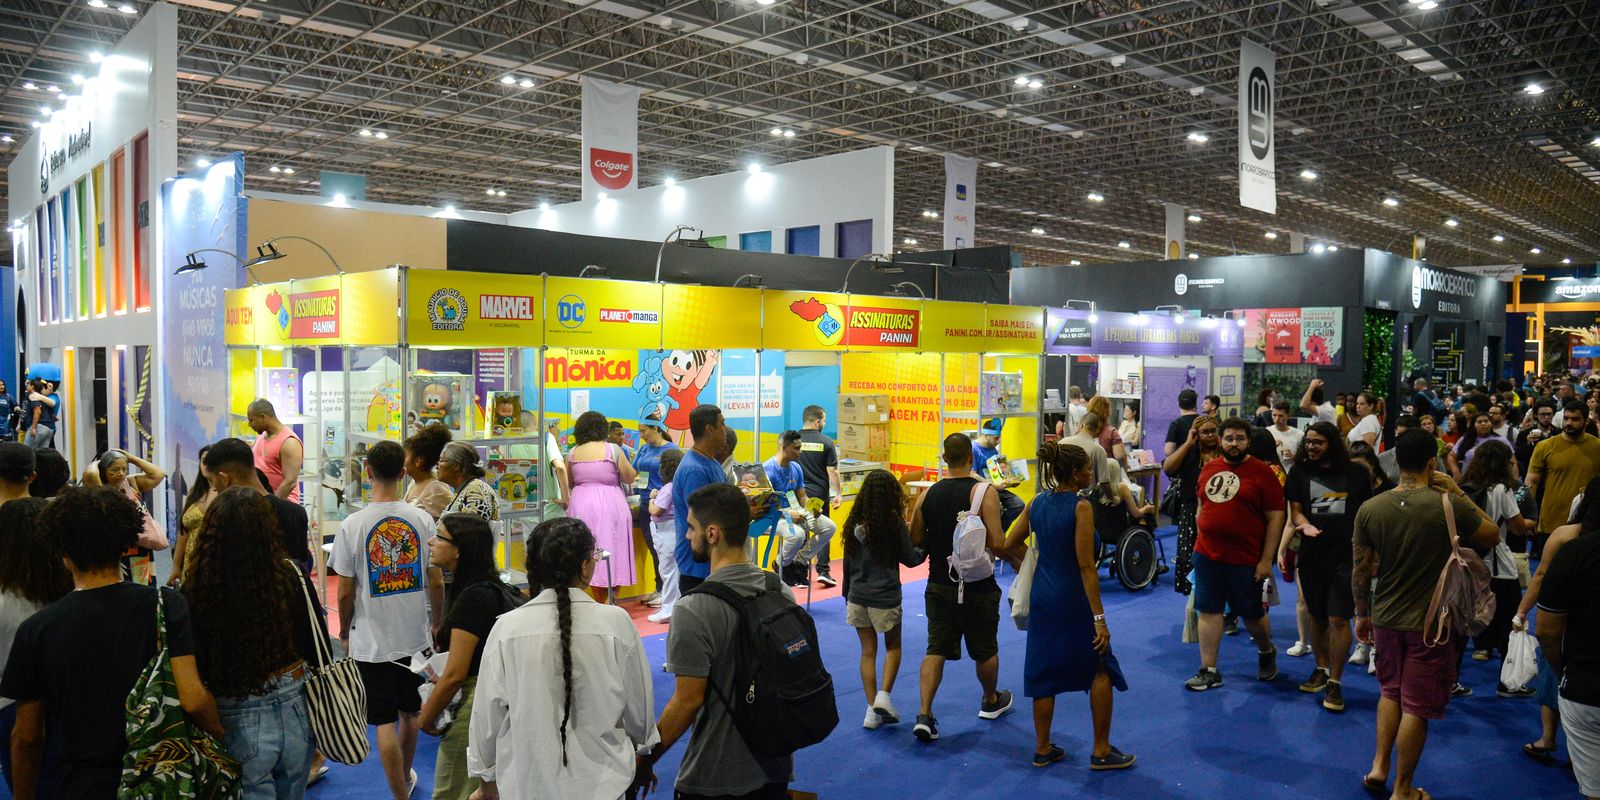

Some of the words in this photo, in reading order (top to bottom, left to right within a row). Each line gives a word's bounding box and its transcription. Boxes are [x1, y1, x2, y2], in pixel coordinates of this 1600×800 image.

[594, 160, 628, 171] Colgate
[1555, 285, 1600, 294] amazon
[180, 286, 216, 311] MÚSICAS
[294, 296, 336, 318] ASSINATURAS
[428, 288, 448, 320] MAURICIO
[449, 288, 460, 297] DE
[458, 296, 468, 323] SOUSA
[480, 296, 532, 319] MARVEL
[558, 302, 584, 322] DC
[1438, 301, 1460, 313] EDITORA
[226, 308, 239, 325] AQUI
[240, 307, 252, 324] TEM
[600, 310, 626, 320] PLANET
[633, 312, 657, 321] manga
[850, 311, 915, 330] ASSINATURAS
[312, 320, 336, 333] PANINI
[1304, 329, 1311, 337] LE
[1313, 329, 1334, 337] GUIN
[880, 332, 912, 343] PANINI
[1104, 327, 1108, 342] A
[1110, 328, 1136, 344] PEQUENA
[183, 346, 213, 367] NUNCA
[888, 382, 926, 392] CONFORTO
[928, 384, 938, 392] DA
[944, 384, 956, 392] UA
[957, 385, 978, 393] CASA
[724, 400, 780, 410] #LEVANTAMÃO
[892, 396, 933, 405] GARANTIDA
[936, 398, 952, 406] CM
[961, 399, 976, 407] SEU
[889, 409, 918, 422] AGEM
[1208, 475, 1224, 496] 9
[1226, 475, 1236, 485] 3
[1222, 488, 1229, 498] 4
